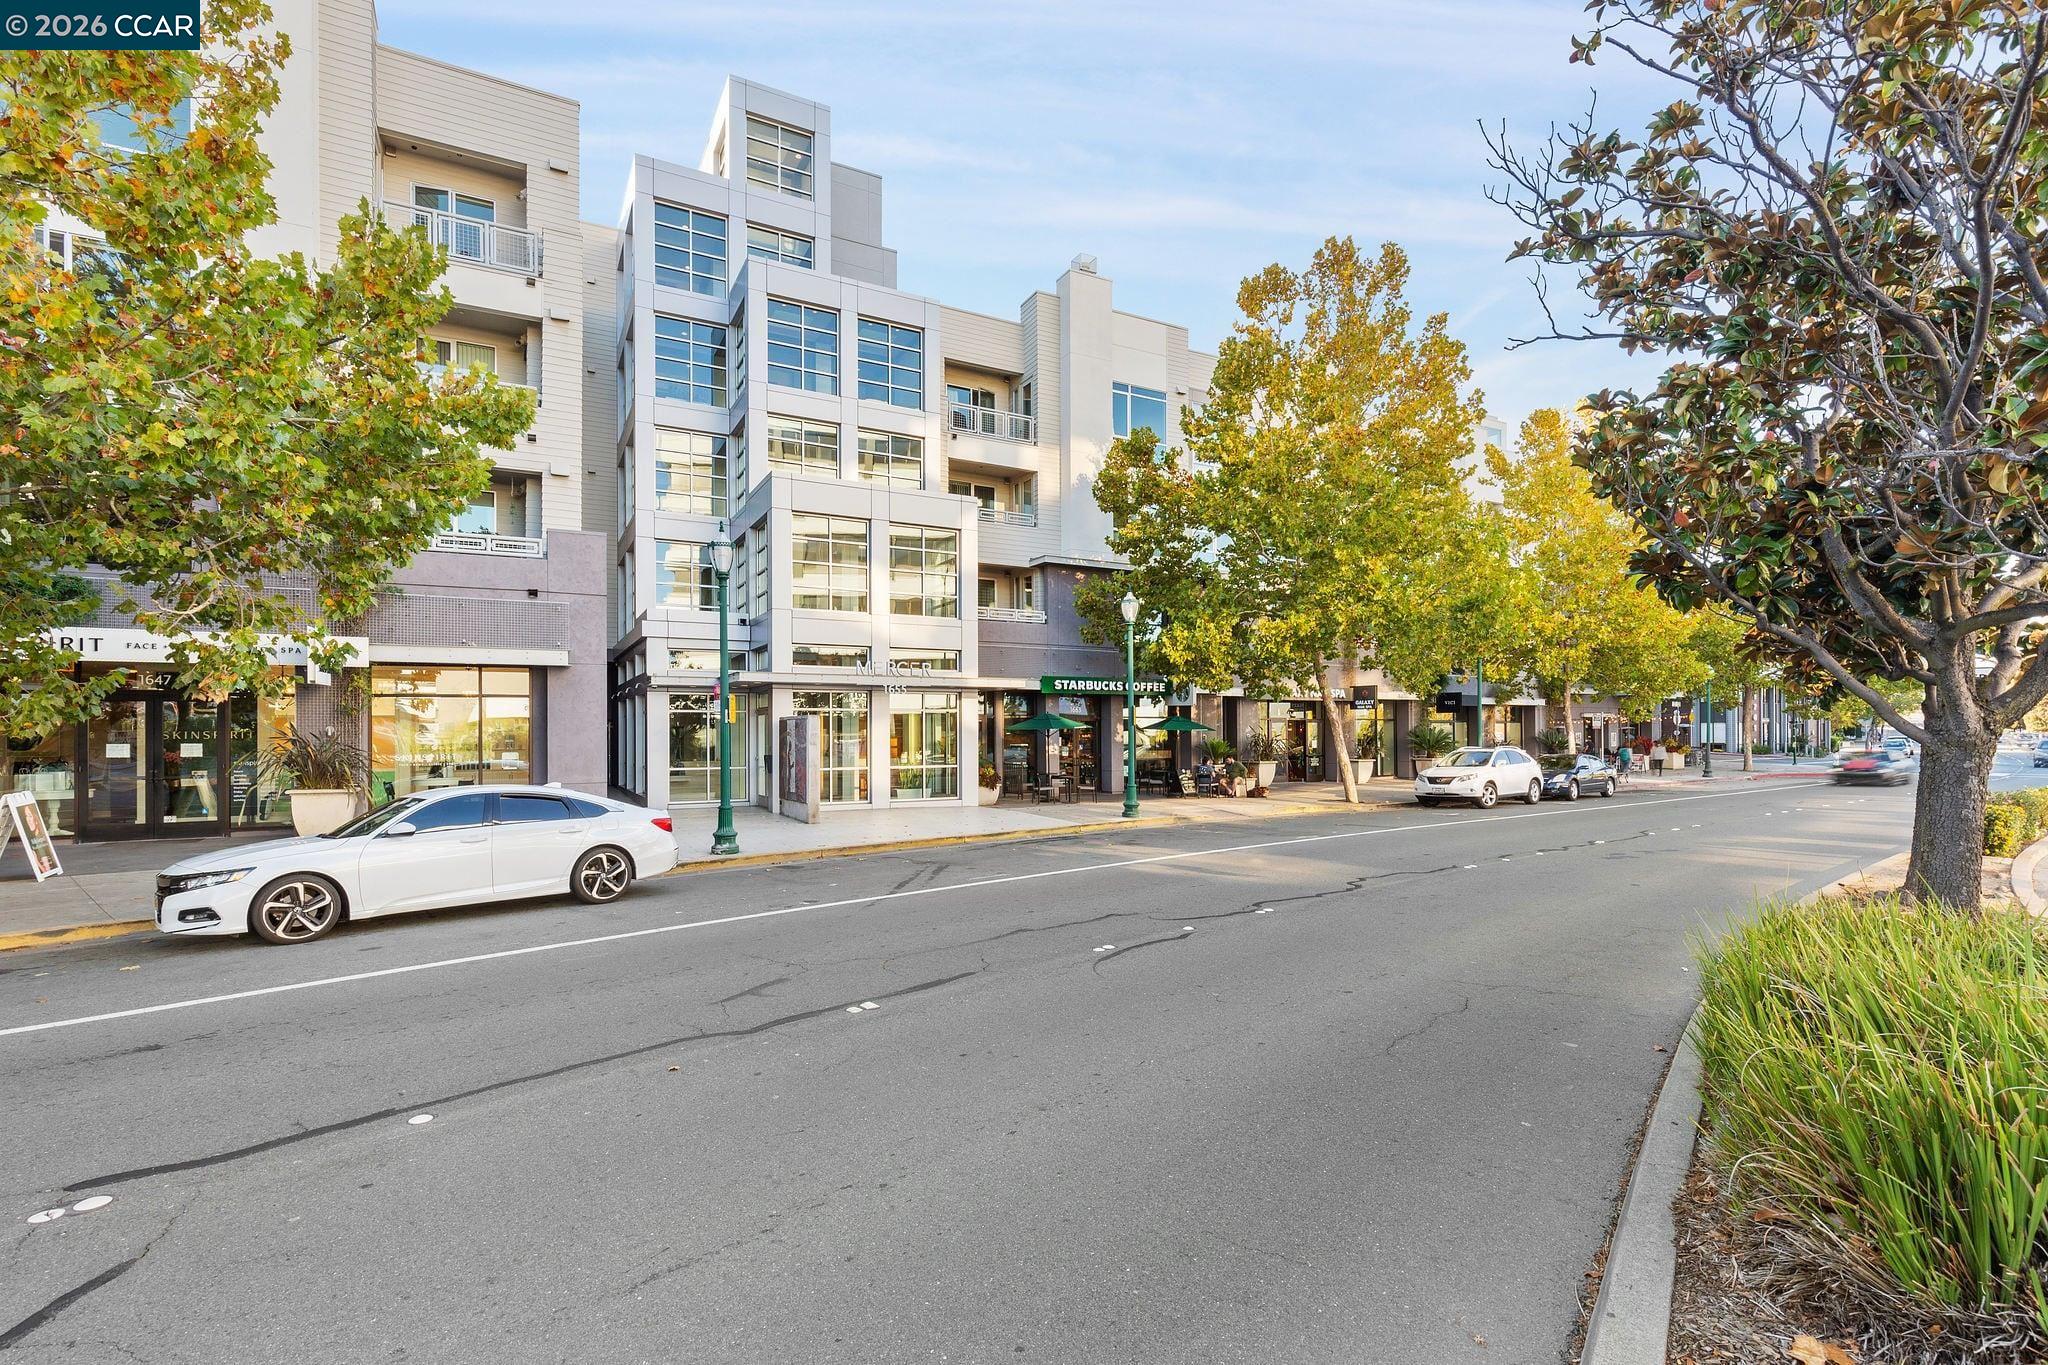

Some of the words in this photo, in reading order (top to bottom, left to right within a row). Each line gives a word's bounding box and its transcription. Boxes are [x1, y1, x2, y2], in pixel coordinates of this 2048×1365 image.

[126, 642, 157, 650] FACE
[856, 660, 931, 677] MERCER
[138, 674, 171, 685] 1647
[884, 684, 907, 694] 1655
[1054, 679, 1123, 692] STARBUCKS
[1126, 682, 1166, 692] OFFEE
[1330, 688, 1346, 698] SPA
[163, 730, 252, 740] SKINSRIT
